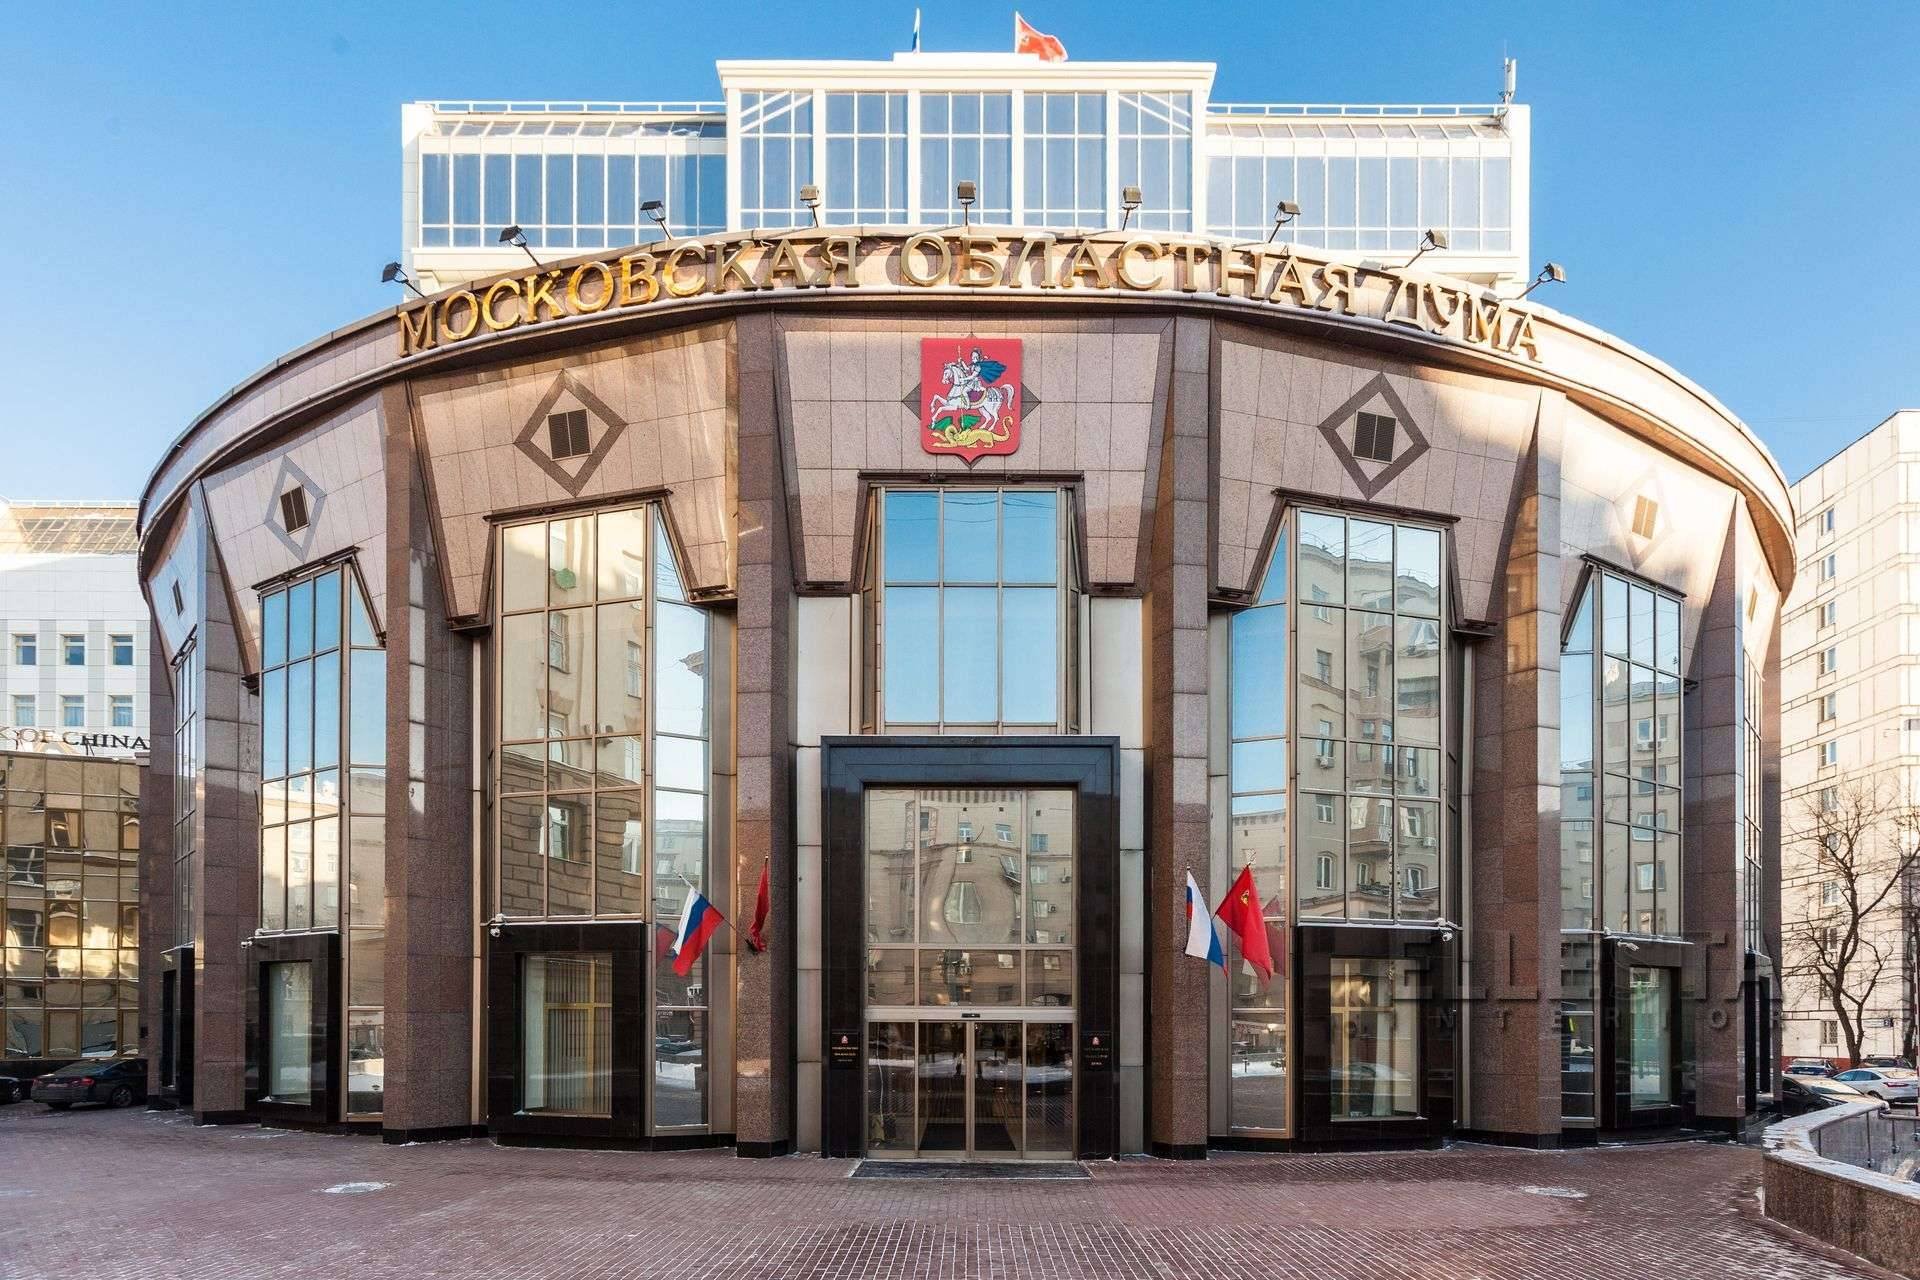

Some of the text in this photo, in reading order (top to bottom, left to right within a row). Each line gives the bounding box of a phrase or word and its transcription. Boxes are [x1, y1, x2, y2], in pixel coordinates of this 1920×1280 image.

[398, 233, 1543, 364] МОСКОВСКАЯ ОБЛАСТНАЯ ДУМА
[20, 728, 56, 744] OF
[62, 731, 150, 750] CHINA
